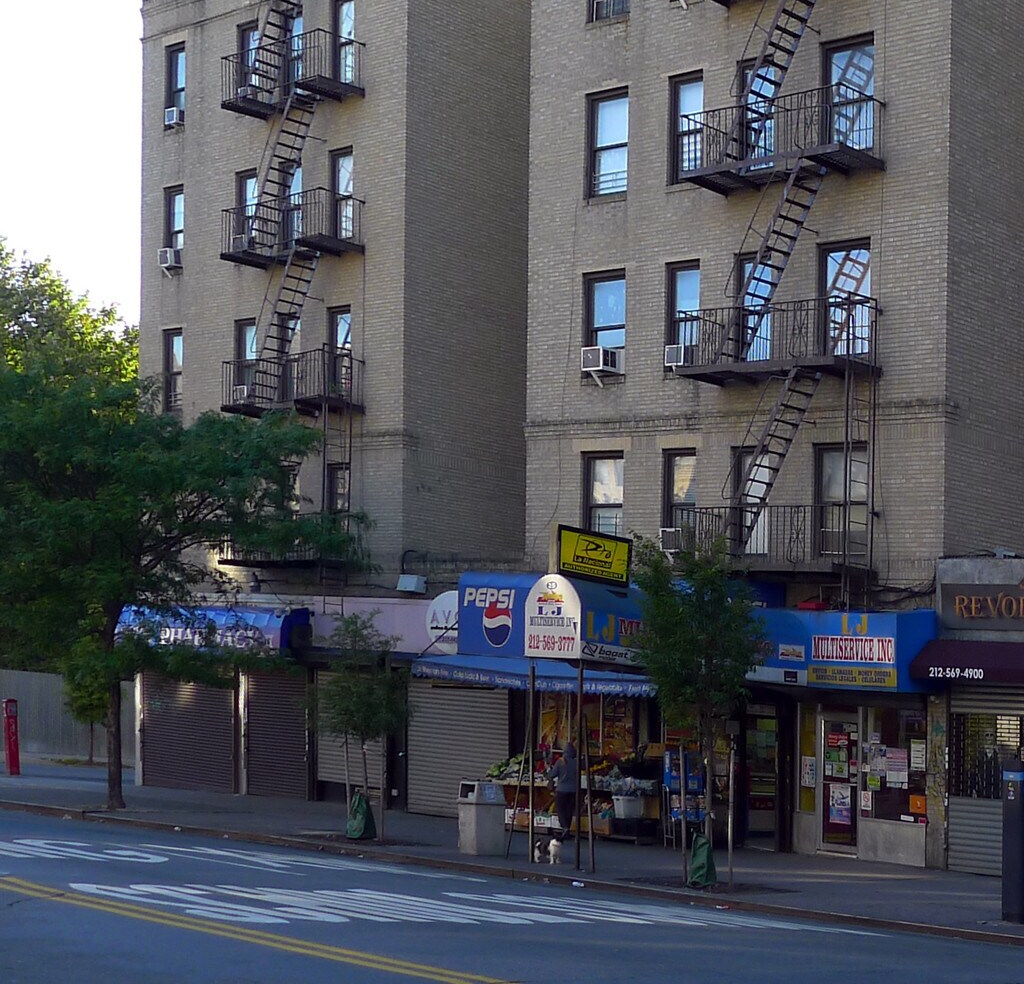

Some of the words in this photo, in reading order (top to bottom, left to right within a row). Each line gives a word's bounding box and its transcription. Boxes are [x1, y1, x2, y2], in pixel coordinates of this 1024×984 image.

[463, 587, 516, 609] PEPSI
[528, 634, 575, 652] 212-569-3777
[813, 636, 874, 661] MULTISERVICE
[928, 667, 984, 680] 212-569-4900
